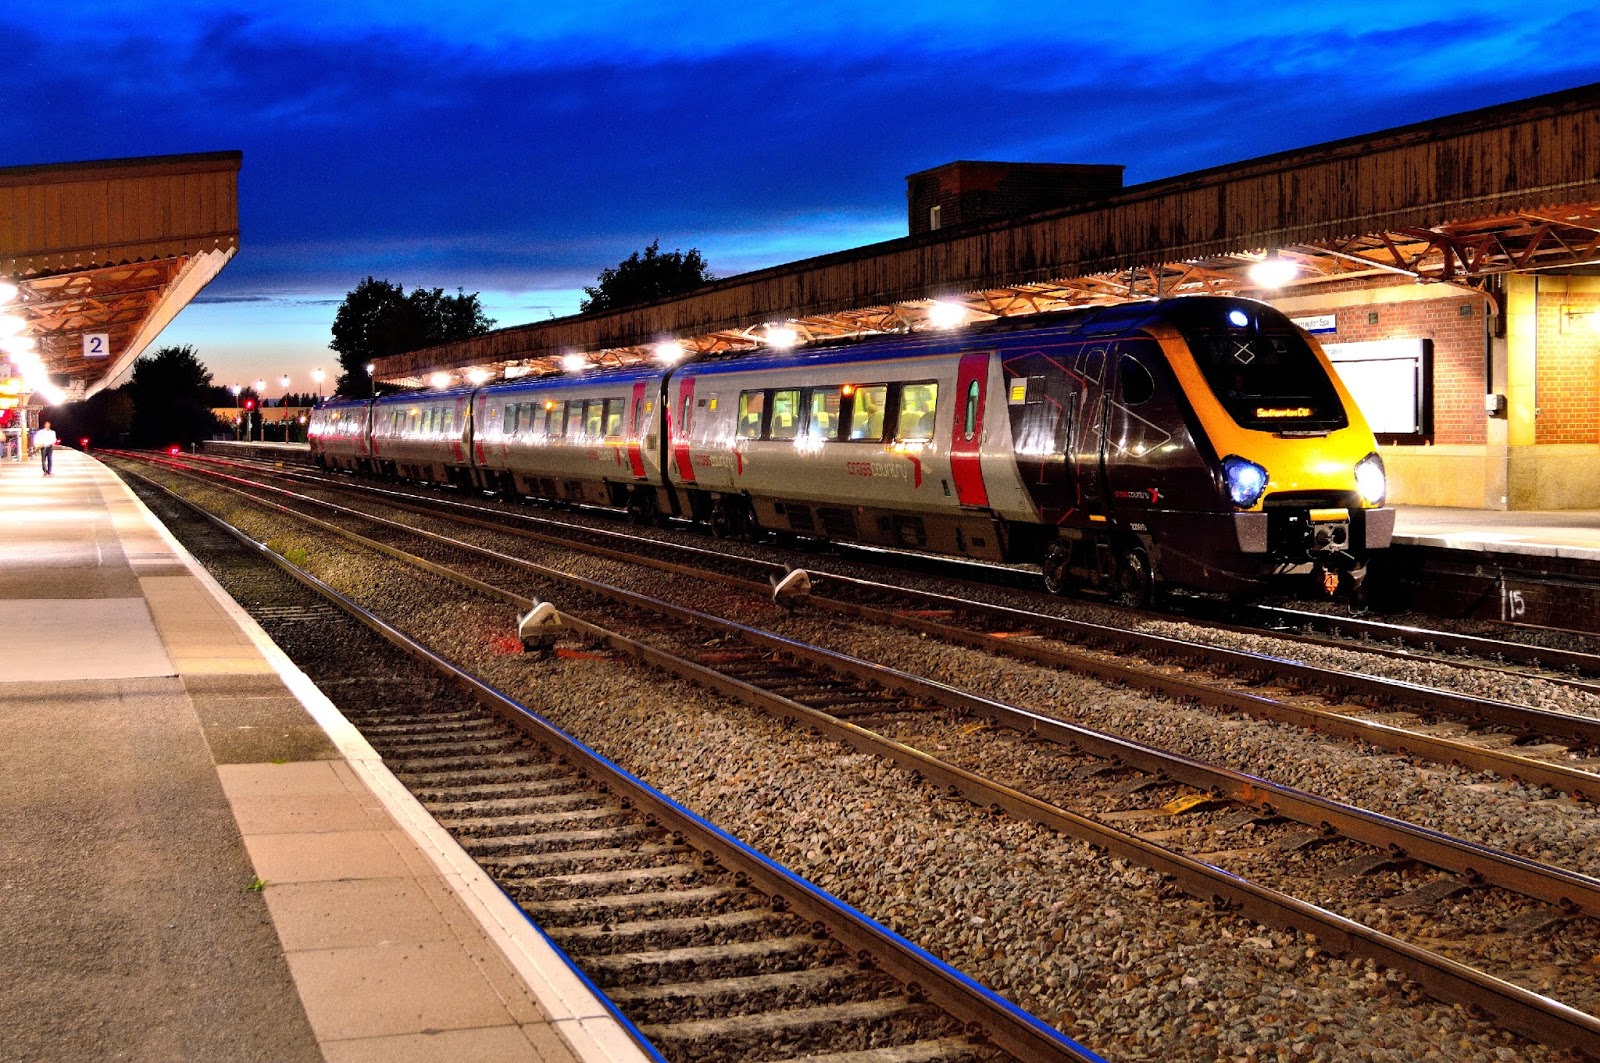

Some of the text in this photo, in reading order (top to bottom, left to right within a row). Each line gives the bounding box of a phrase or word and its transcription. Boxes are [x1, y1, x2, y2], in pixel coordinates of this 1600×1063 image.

[1319, 318, 1330, 328] Spa
[90, 336, 103, 353] 2
[847, 462, 908, 482] crosscountry
[1509, 590, 1525, 618] 15
